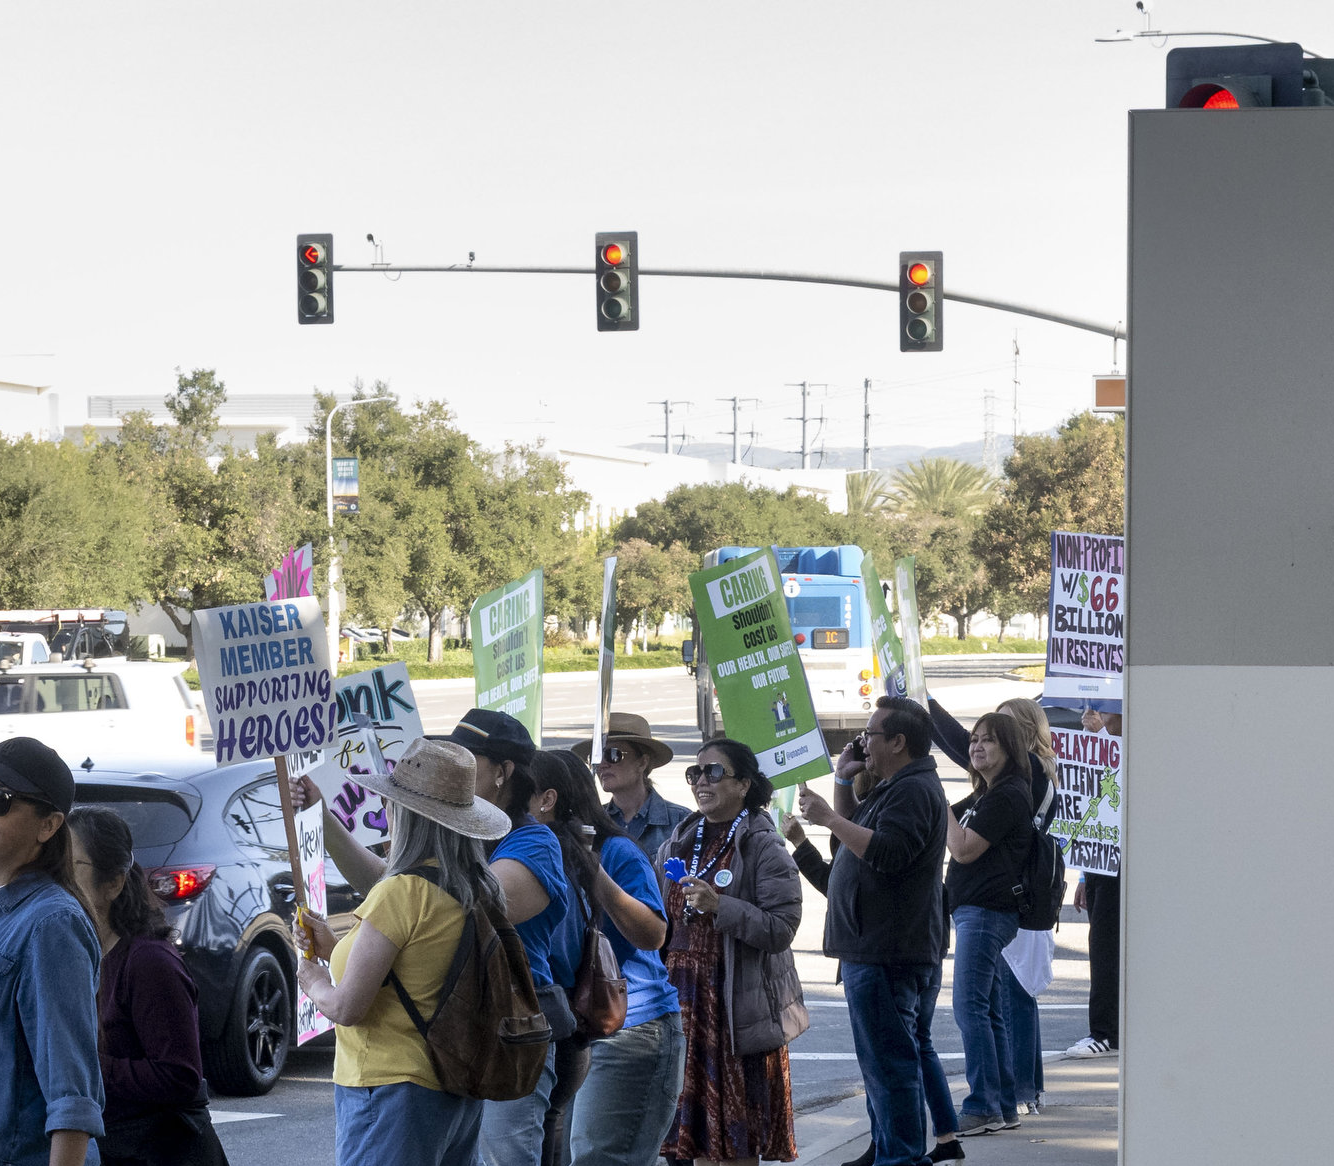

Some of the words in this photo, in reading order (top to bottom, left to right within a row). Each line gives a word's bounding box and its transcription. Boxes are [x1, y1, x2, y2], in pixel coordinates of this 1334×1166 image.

[719, 565, 770, 609] CARING
[219, 603, 303, 640] KAISER
[489, 589, 530, 637] CARING
[732, 599, 776, 631] shouldn't
[1054, 604, 1124, 638] BILLION
[493, 625, 528, 660] shouldn't
[743, 630, 768, 650] cost
[766, 623, 779, 642] us
[825, 631, 838, 643] IC
[220, 637, 314, 677] MEMBER
[497, 655, 513, 680] cost
[516, 652, 526, 672] us
[717, 660, 737, 678] OUR
[737, 650, 769, 672] HEALTH,
[767, 645, 781, 662] OUR
[1051, 637, 1063, 664] IN
[1067, 638, 1124, 673] RESERVES
[215, 669, 331, 714] SUPPORTING
[751, 672, 768, 690] OUR
[767, 665, 790, 685] FUTURE
[217, 702, 337, 763] HEROES!
[1051, 732, 1120, 769] DELAYING
[1057, 763, 1104, 798] ATIENT
[1056, 794, 1082, 820] ARE
[1070, 839, 1120, 872] RESERVES
